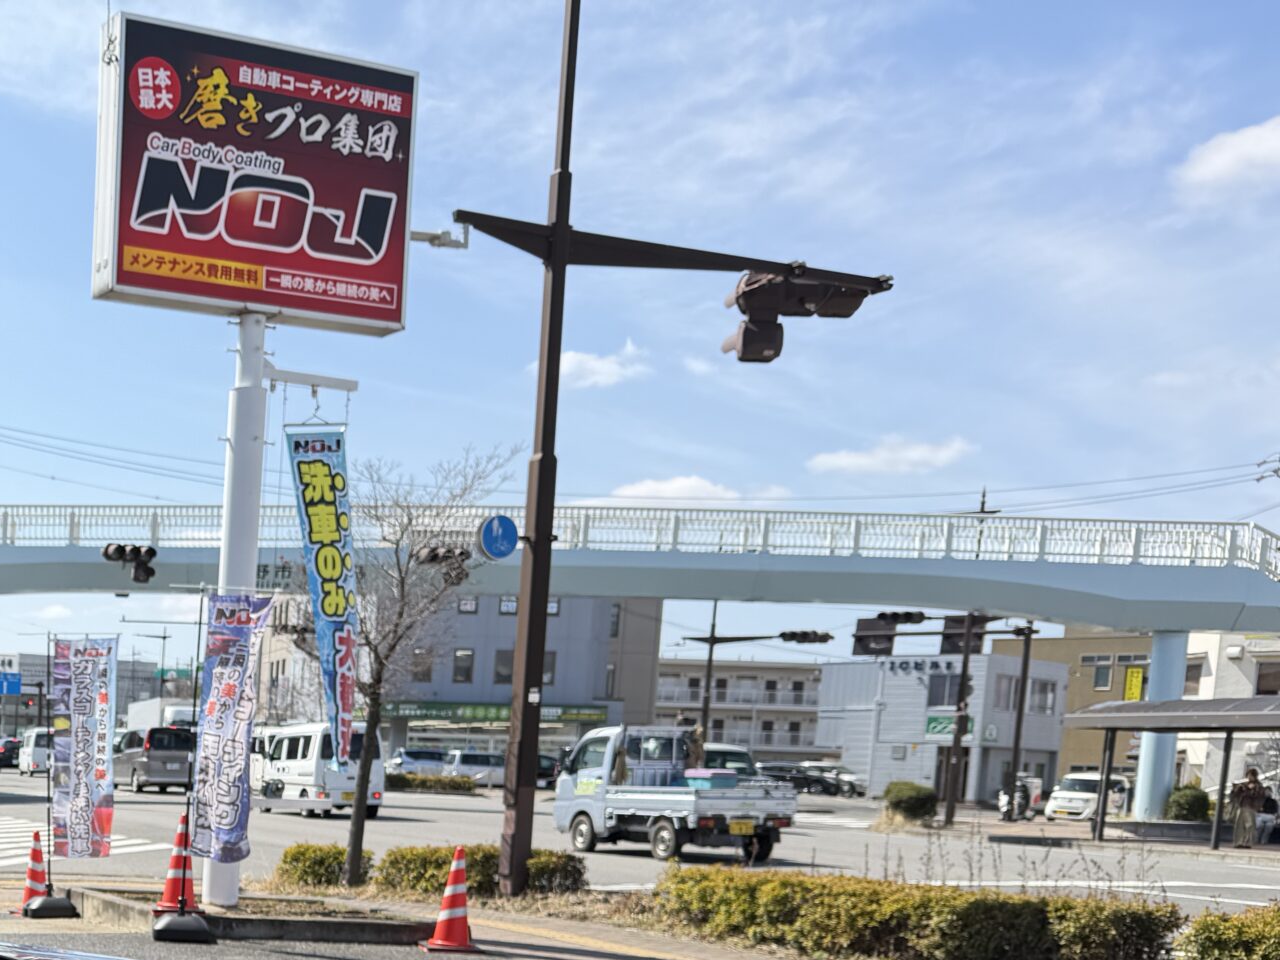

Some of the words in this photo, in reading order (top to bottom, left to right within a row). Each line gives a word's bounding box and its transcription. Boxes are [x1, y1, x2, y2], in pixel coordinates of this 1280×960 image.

[138, 67, 171, 88] 日本
[239, 66, 402, 112] 自動車コーティング専門店
[139, 88, 173, 109] 最大
[180, 67, 399, 162] 磨きプロ集団
[148, 134, 177, 154] Car
[180, 140, 222, 163] Body
[223, 148, 283, 175] Coating
[130, 151, 397, 265] NOJ
[130, 252, 259, 283] メンテナンス費用無料
[293, 439, 341, 454] NOJ
[74, 646, 112, 657] NOJ
